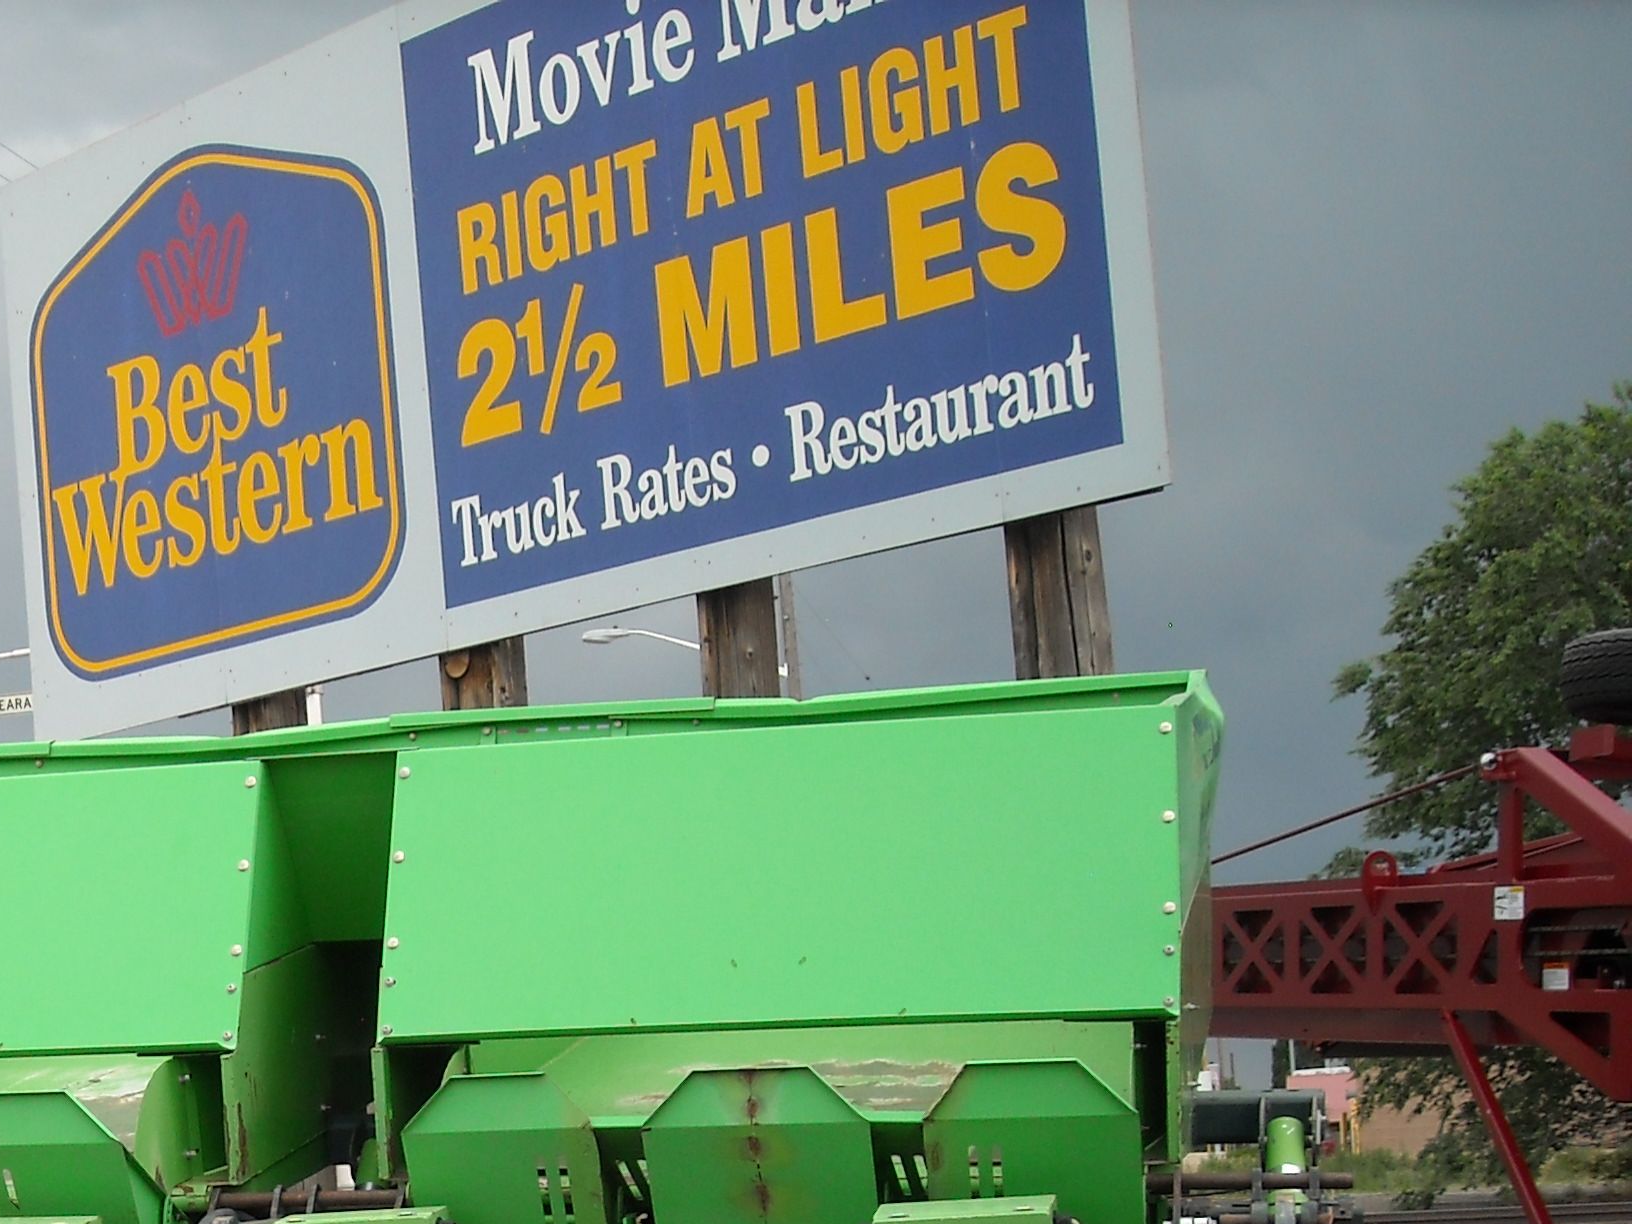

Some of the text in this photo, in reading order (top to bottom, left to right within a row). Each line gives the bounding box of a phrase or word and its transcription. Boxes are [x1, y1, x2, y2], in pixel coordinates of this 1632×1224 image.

[456, 4, 1028, 296] RIGHT AT LIGHT
[467, 0, 696, 155] Movie
[654, 141, 1067, 388] MILES
[106, 305, 289, 483] Best
[451, 333, 1095, 567] Truck Rates Restaurant
[52, 410, 384, 597] Western
